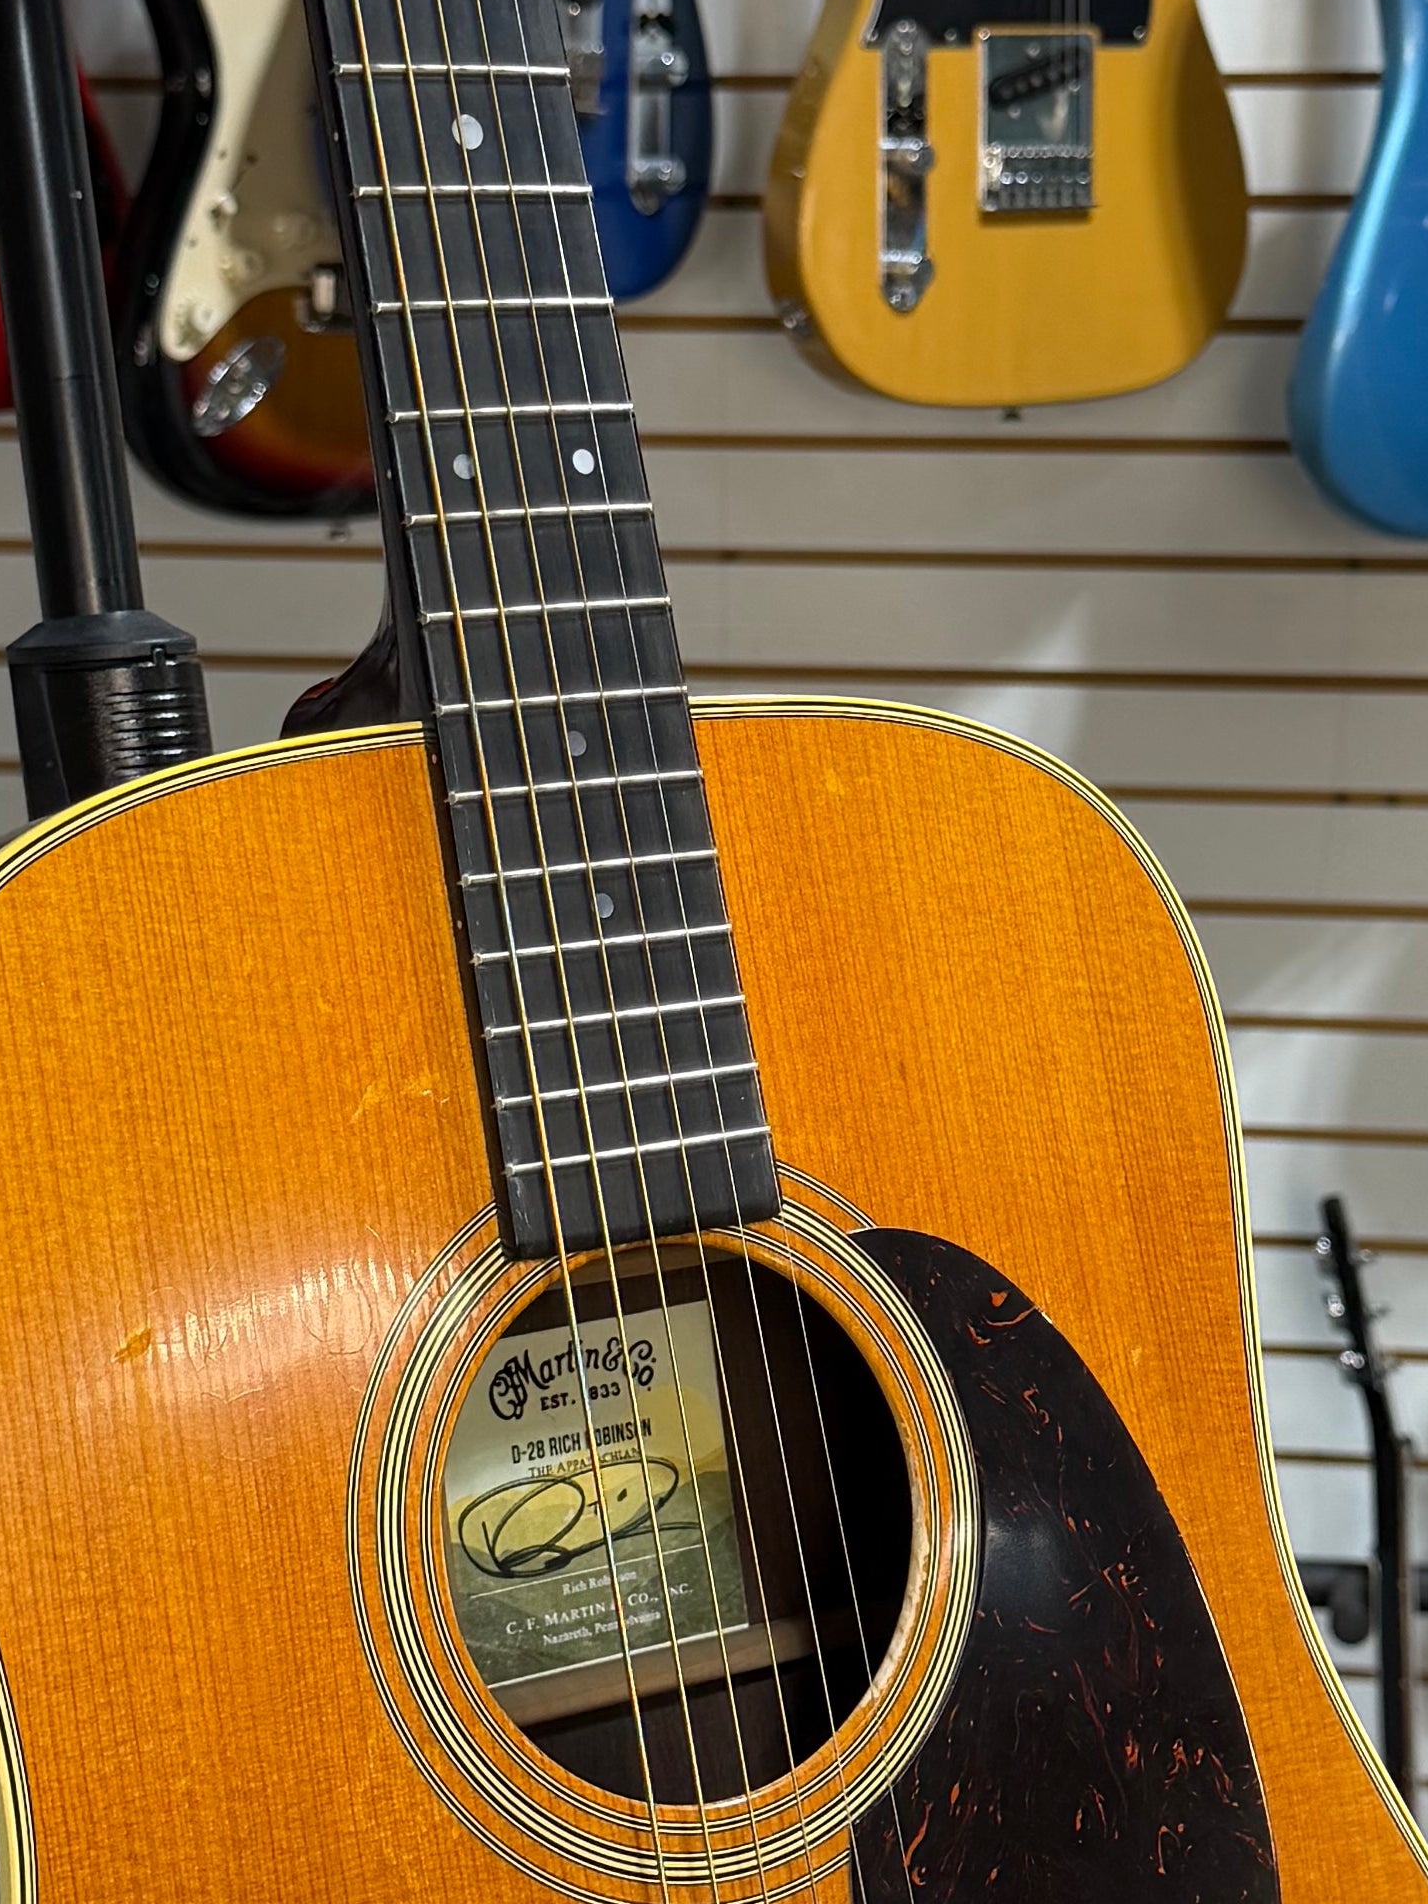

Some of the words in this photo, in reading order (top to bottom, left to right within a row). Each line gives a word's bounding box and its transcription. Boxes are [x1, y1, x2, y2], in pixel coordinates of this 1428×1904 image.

[540, 1393, 576, 1411] EST.
[582, 1382, 621, 1401] 833
[511, 1440, 545, 1464] D-28
[549, 1432, 581, 1457] RICH
[585, 1417, 652, 1449] OBINSN
[528, 1465, 555, 1478] THE
[562, 1580, 587, 1596] Rich
[506, 1621, 524, 1635] C.
[527, 1617, 541, 1631] F.
[544, 1602, 606, 1627] MARTIN
[665, 1583, 693, 1597] NC.
